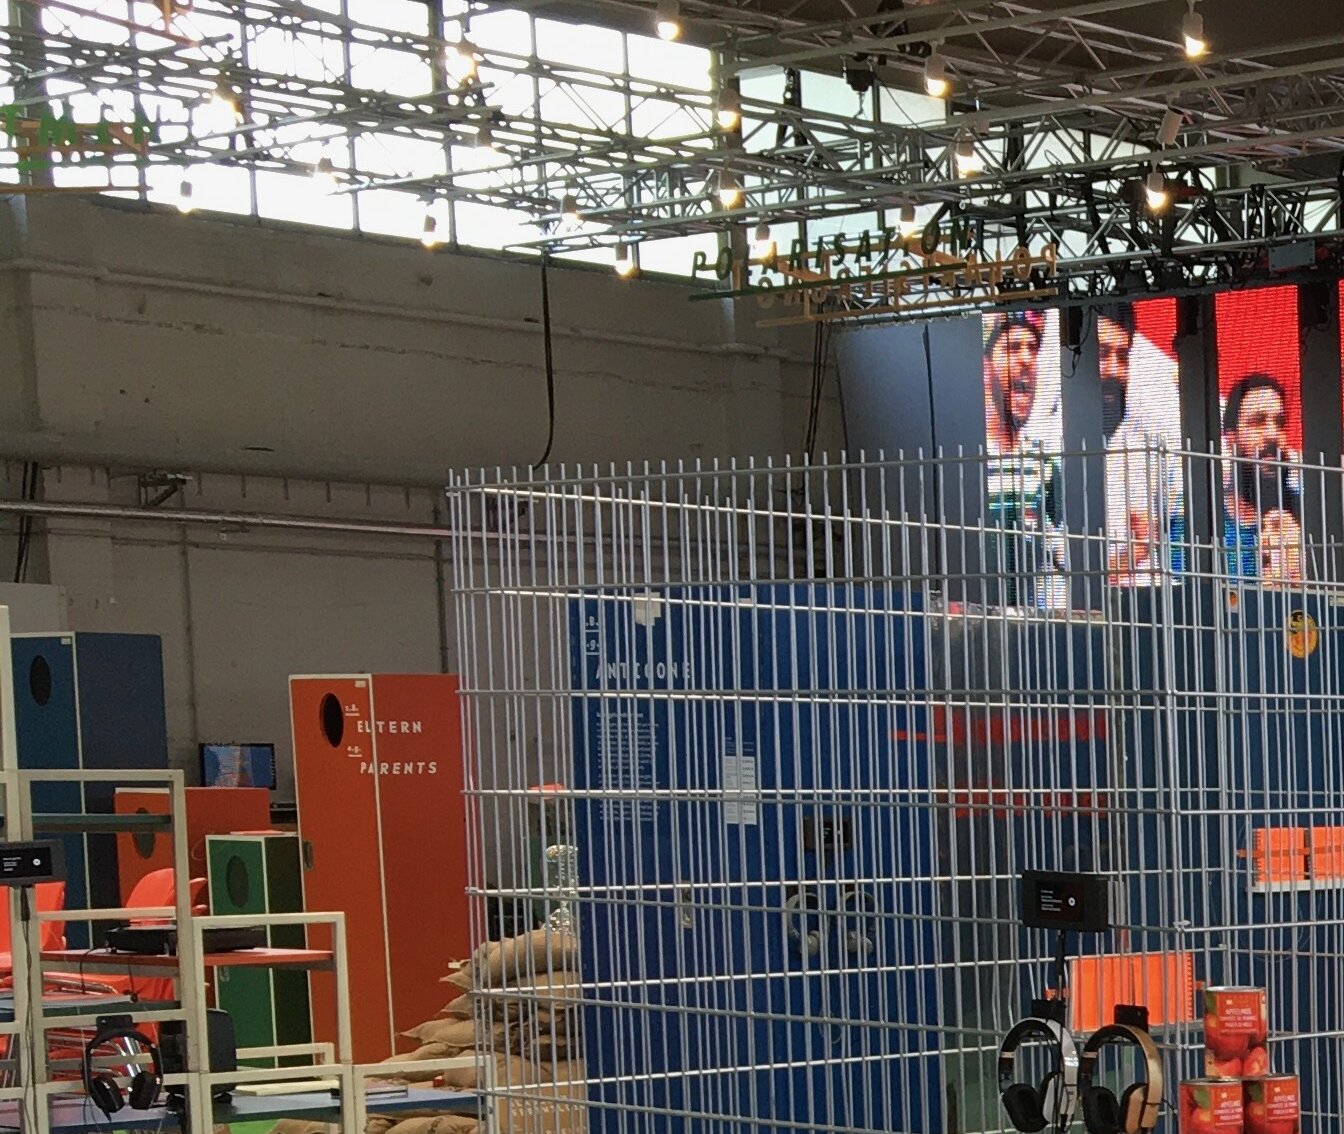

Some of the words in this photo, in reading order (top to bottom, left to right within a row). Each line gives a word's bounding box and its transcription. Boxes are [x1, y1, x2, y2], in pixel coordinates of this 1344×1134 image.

[692, 216, 974, 282] POARISATON
[357, 720, 422, 733] ELTERN
[360, 762, 438, 775] PARENTS
